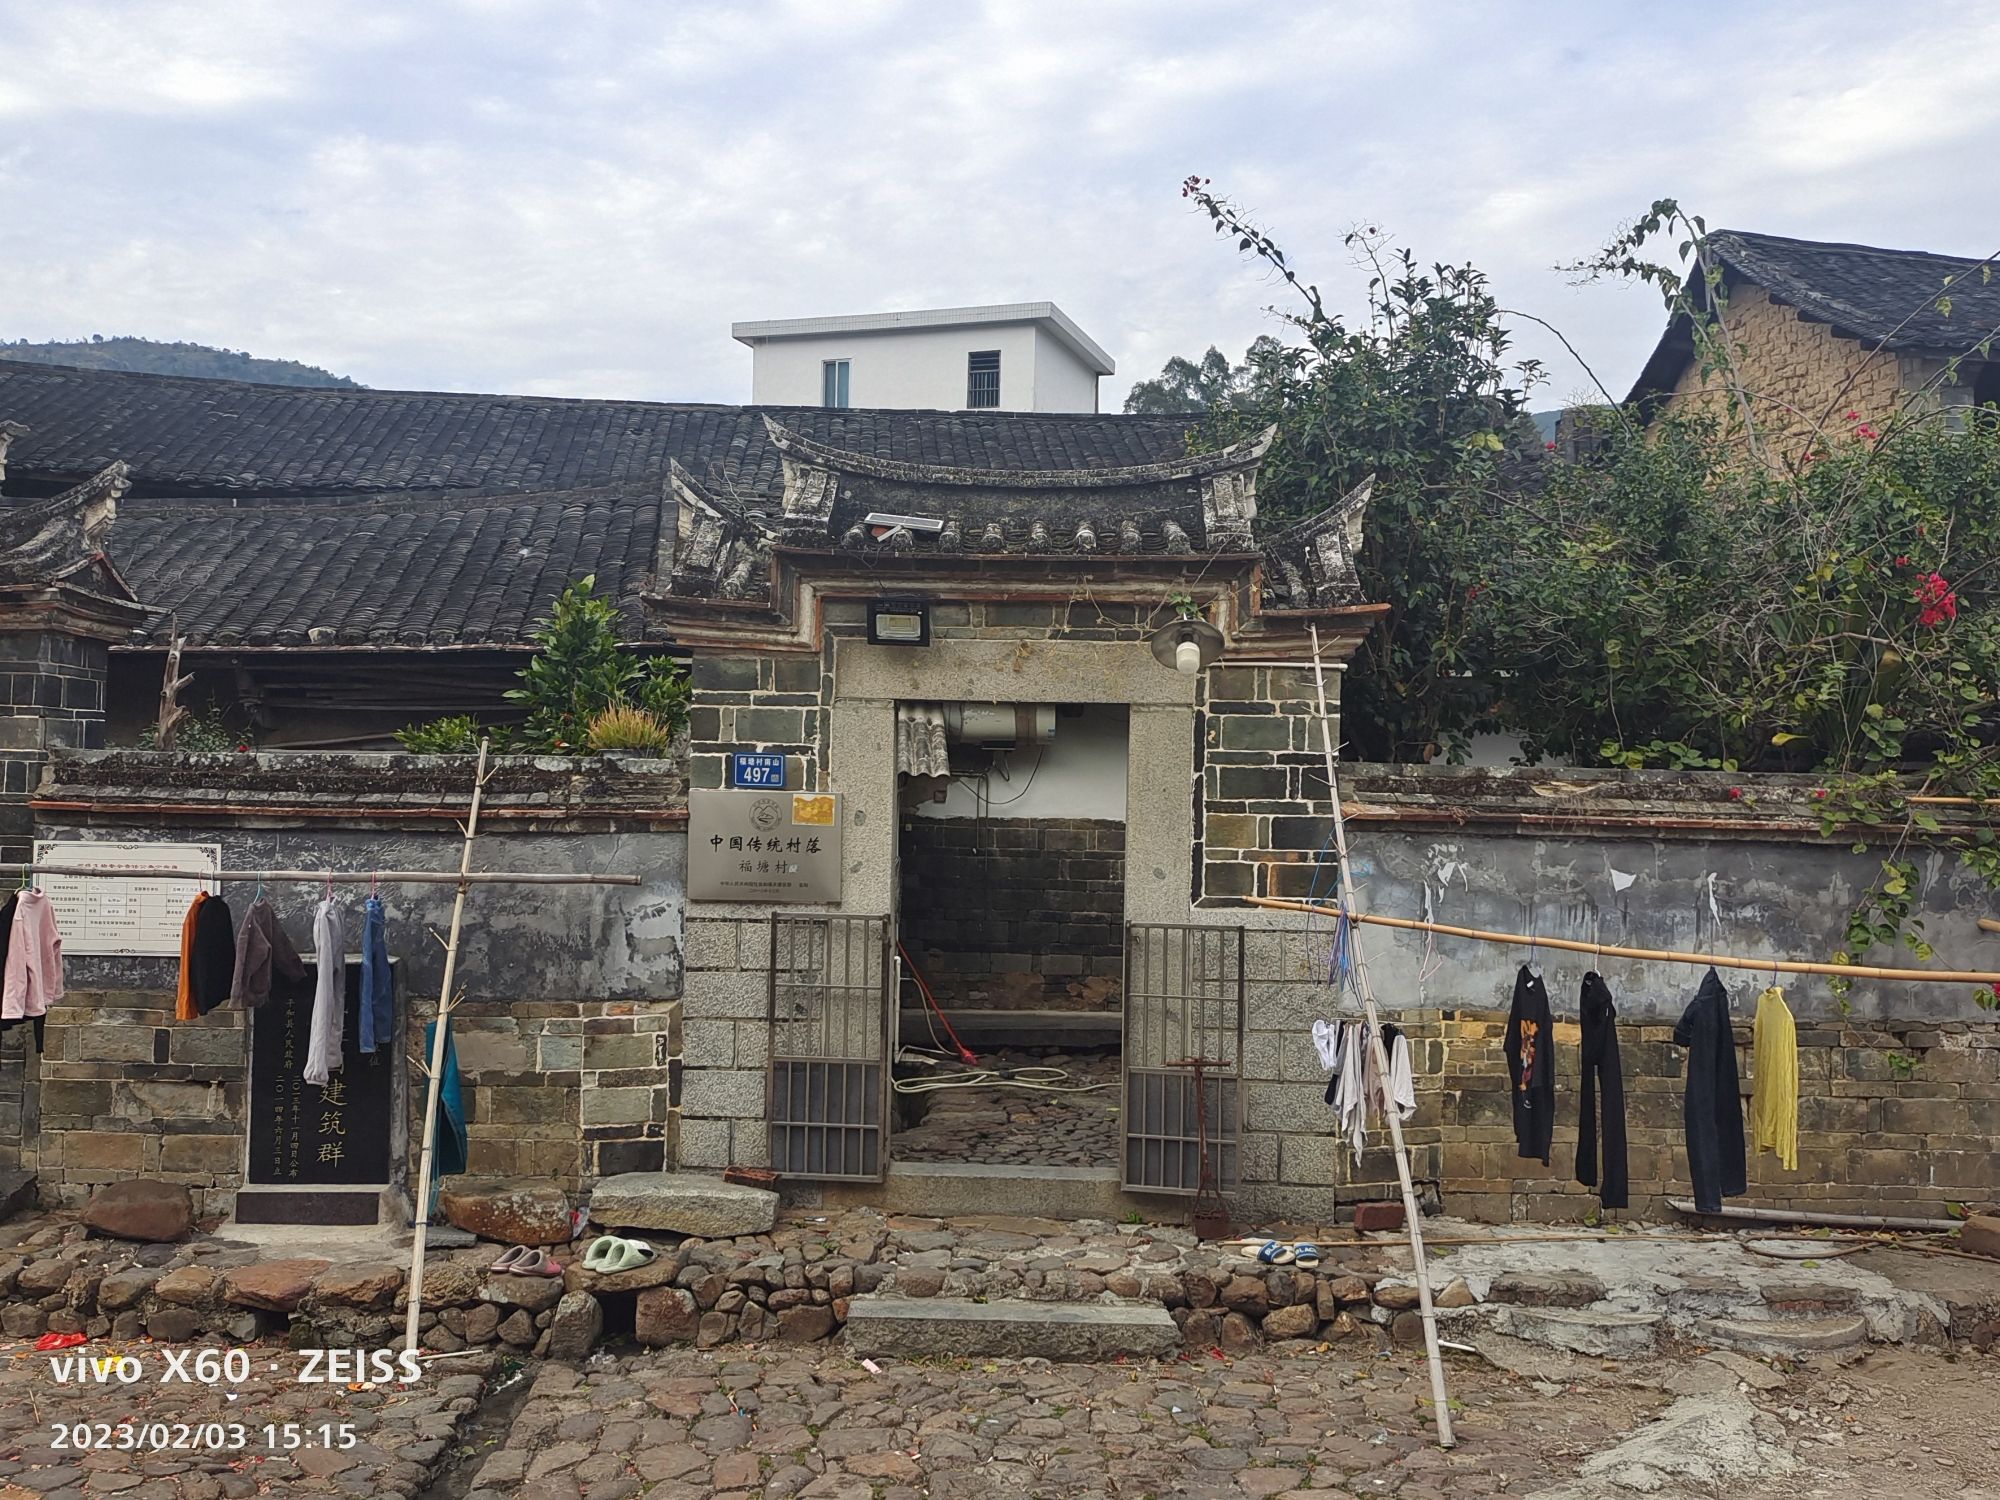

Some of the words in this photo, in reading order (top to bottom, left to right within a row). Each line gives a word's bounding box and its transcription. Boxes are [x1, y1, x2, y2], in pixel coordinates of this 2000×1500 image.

[743, 766, 770, 783] 497
[710, 834, 822, 854] 中国传统村落
[739, 859, 789, 874] 福塘村
